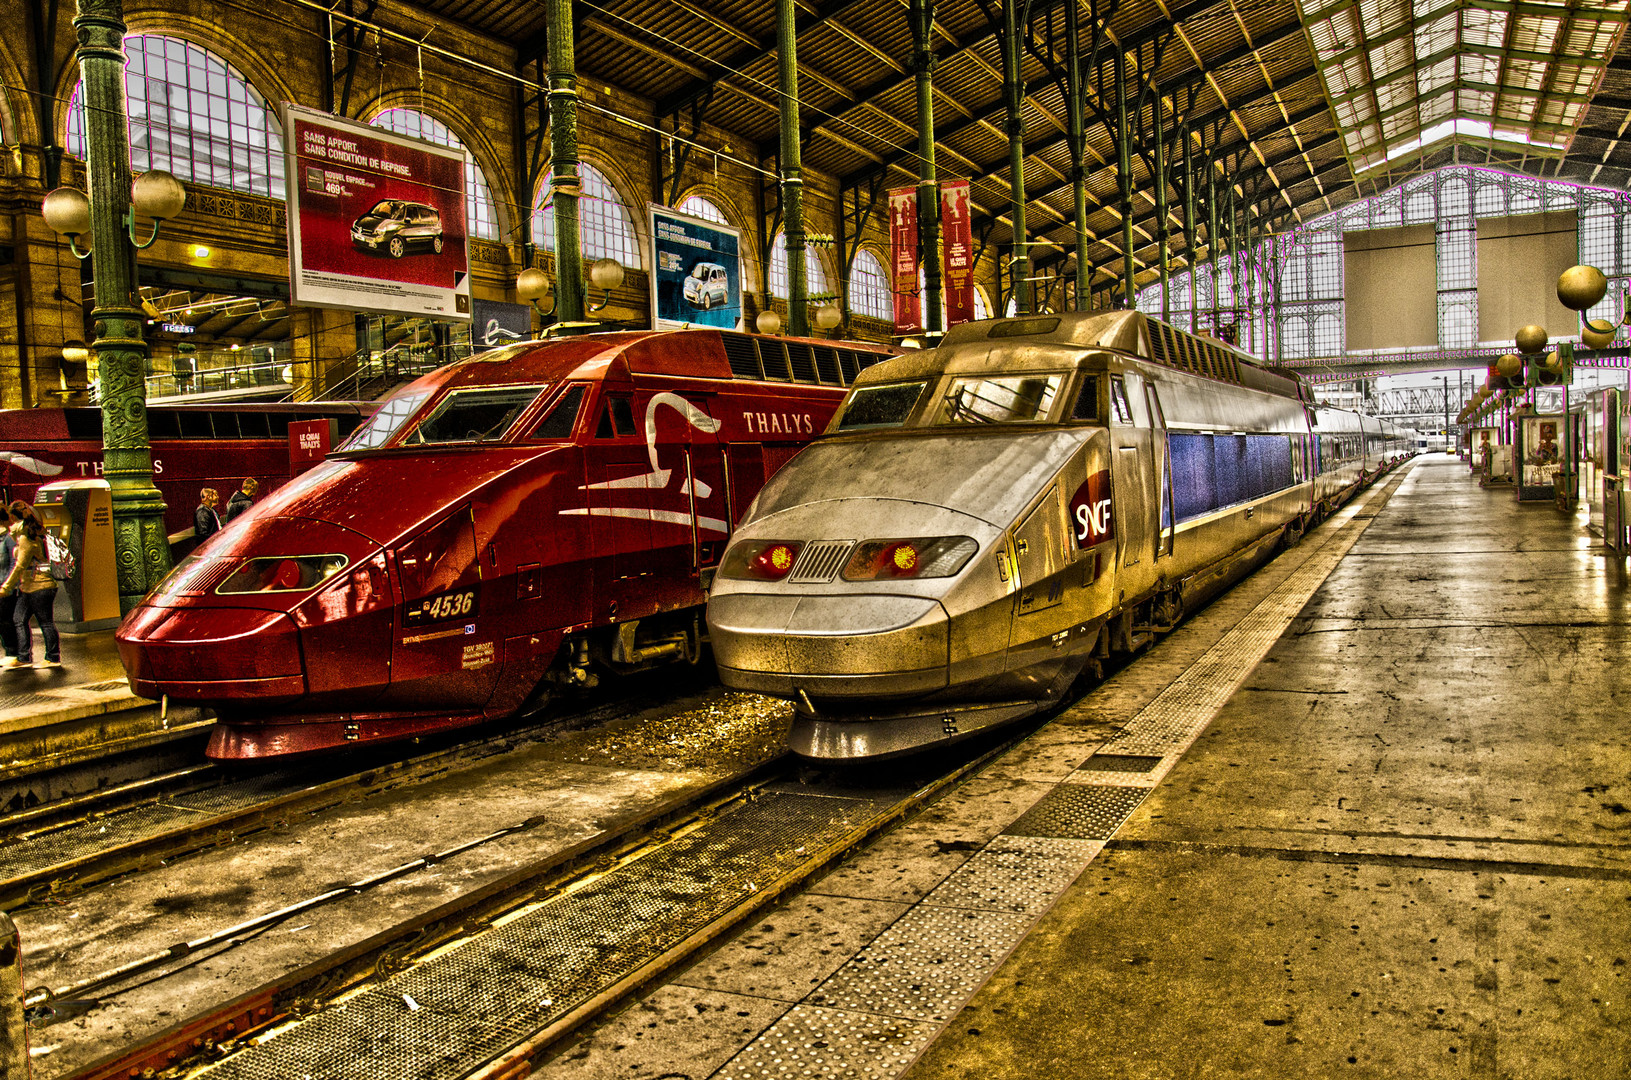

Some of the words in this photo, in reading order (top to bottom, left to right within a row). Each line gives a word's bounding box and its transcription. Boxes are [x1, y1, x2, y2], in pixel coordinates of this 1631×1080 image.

[304, 131, 326, 146] SANS
[327, 136, 359, 153] APPORT.
[304, 142, 327, 157] SANS
[328, 148, 368, 167] CONDITION
[369, 158, 380, 169] DE
[381, 161, 412, 176] REPRISE.
[743, 411, 813, 434] THALYS
[300, 440, 321, 450] THALYS
[76, 459, 164, 477] THS
[1076, 498, 1112, 541] SNCF
[429, 591, 474, 619] 4536
[463, 644, 475, 653] TGV
